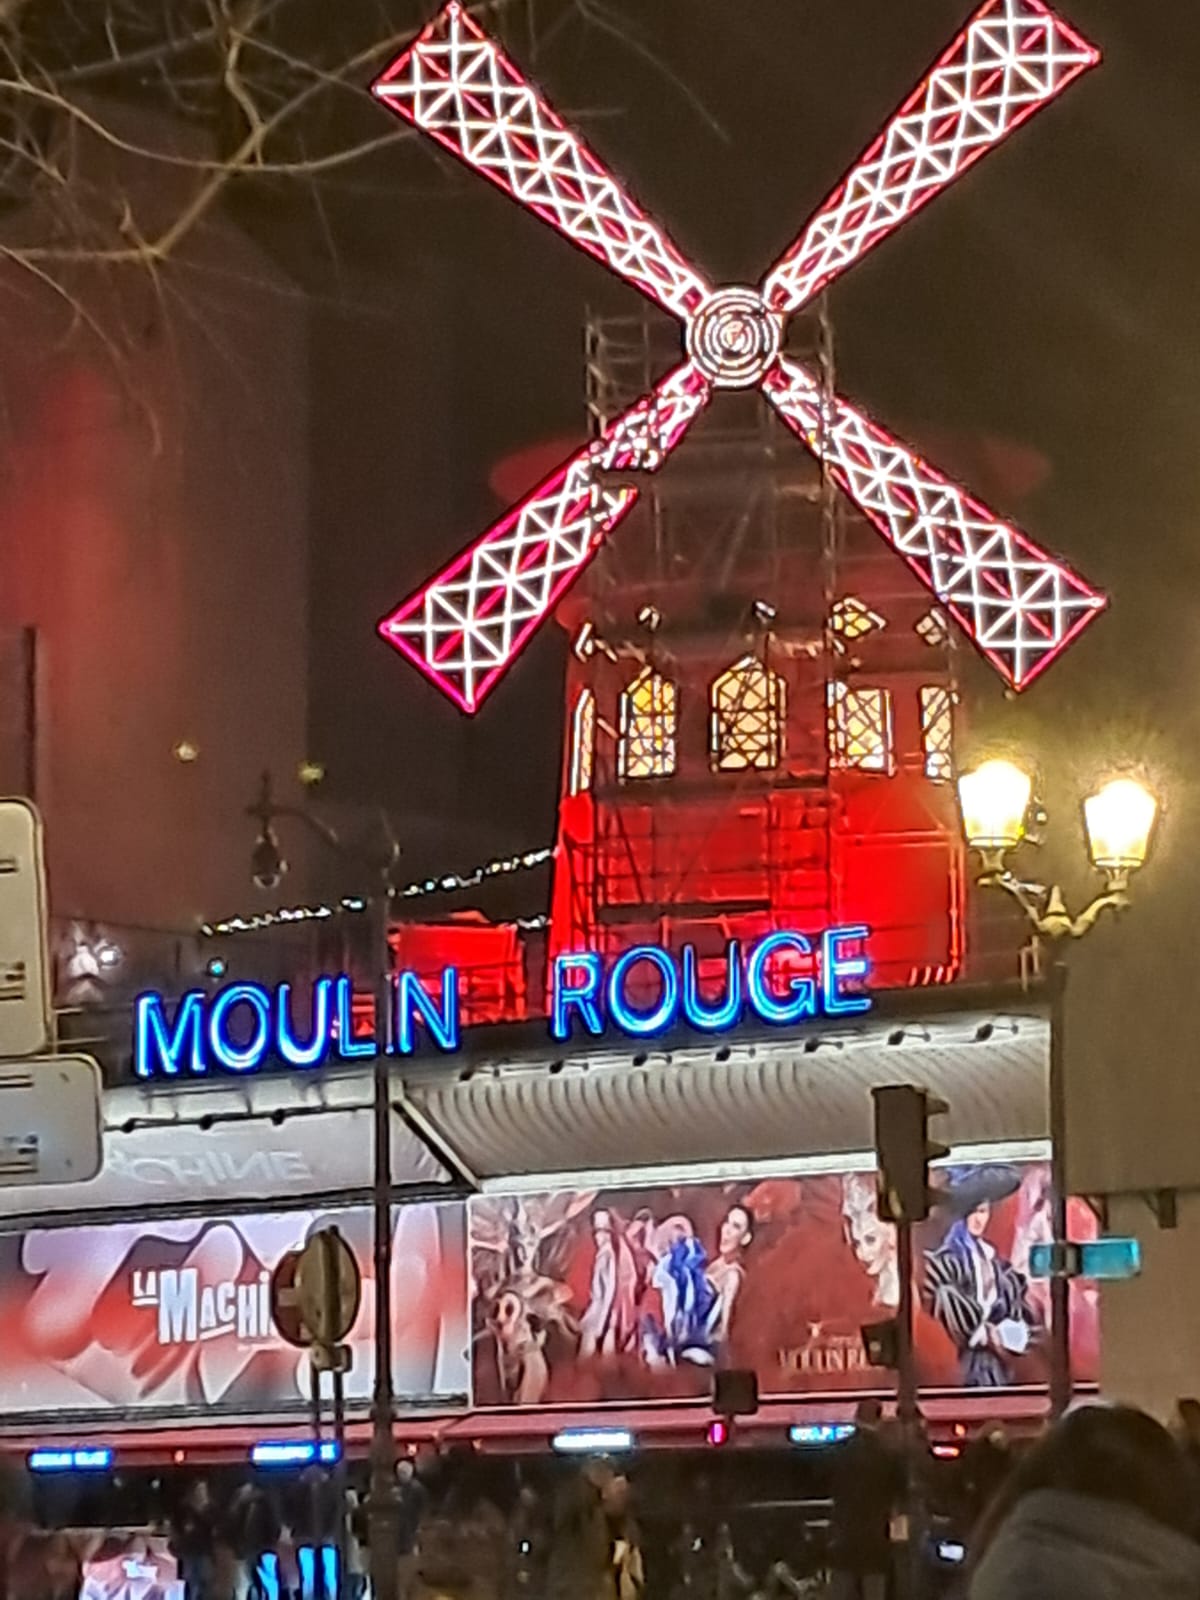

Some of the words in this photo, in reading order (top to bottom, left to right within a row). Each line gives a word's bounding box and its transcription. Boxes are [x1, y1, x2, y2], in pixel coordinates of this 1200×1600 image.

[136, 966, 457, 1078] MOULN
[553, 926, 872, 1038] ROUGE
[133, 1271, 157, 1298] LA
